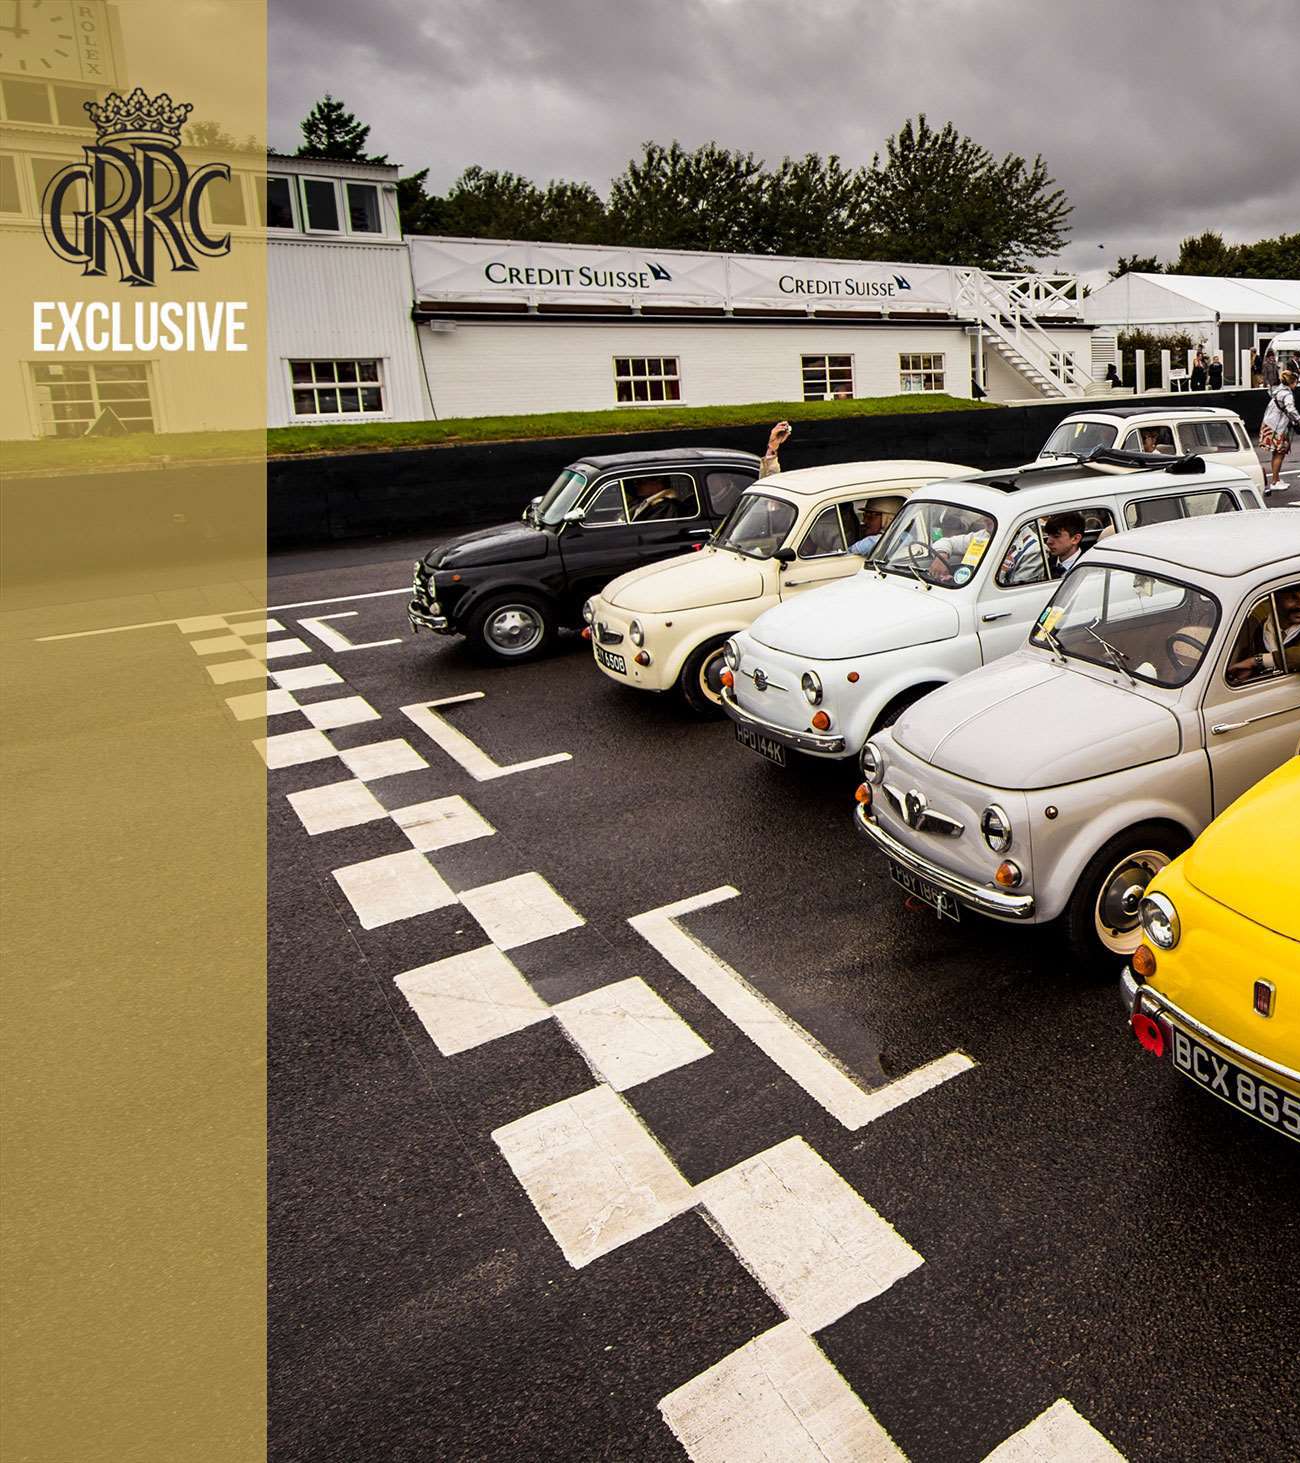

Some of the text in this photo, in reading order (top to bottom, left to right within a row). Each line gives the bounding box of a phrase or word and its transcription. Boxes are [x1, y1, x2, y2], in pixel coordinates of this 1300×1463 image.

[79, 6, 103, 75] ROLEX
[485, 262, 650, 289] CREDIT SUISSE
[778, 275, 896, 296] CREDIT SUISSE
[1175, 1031, 1230, 1097] BCX
